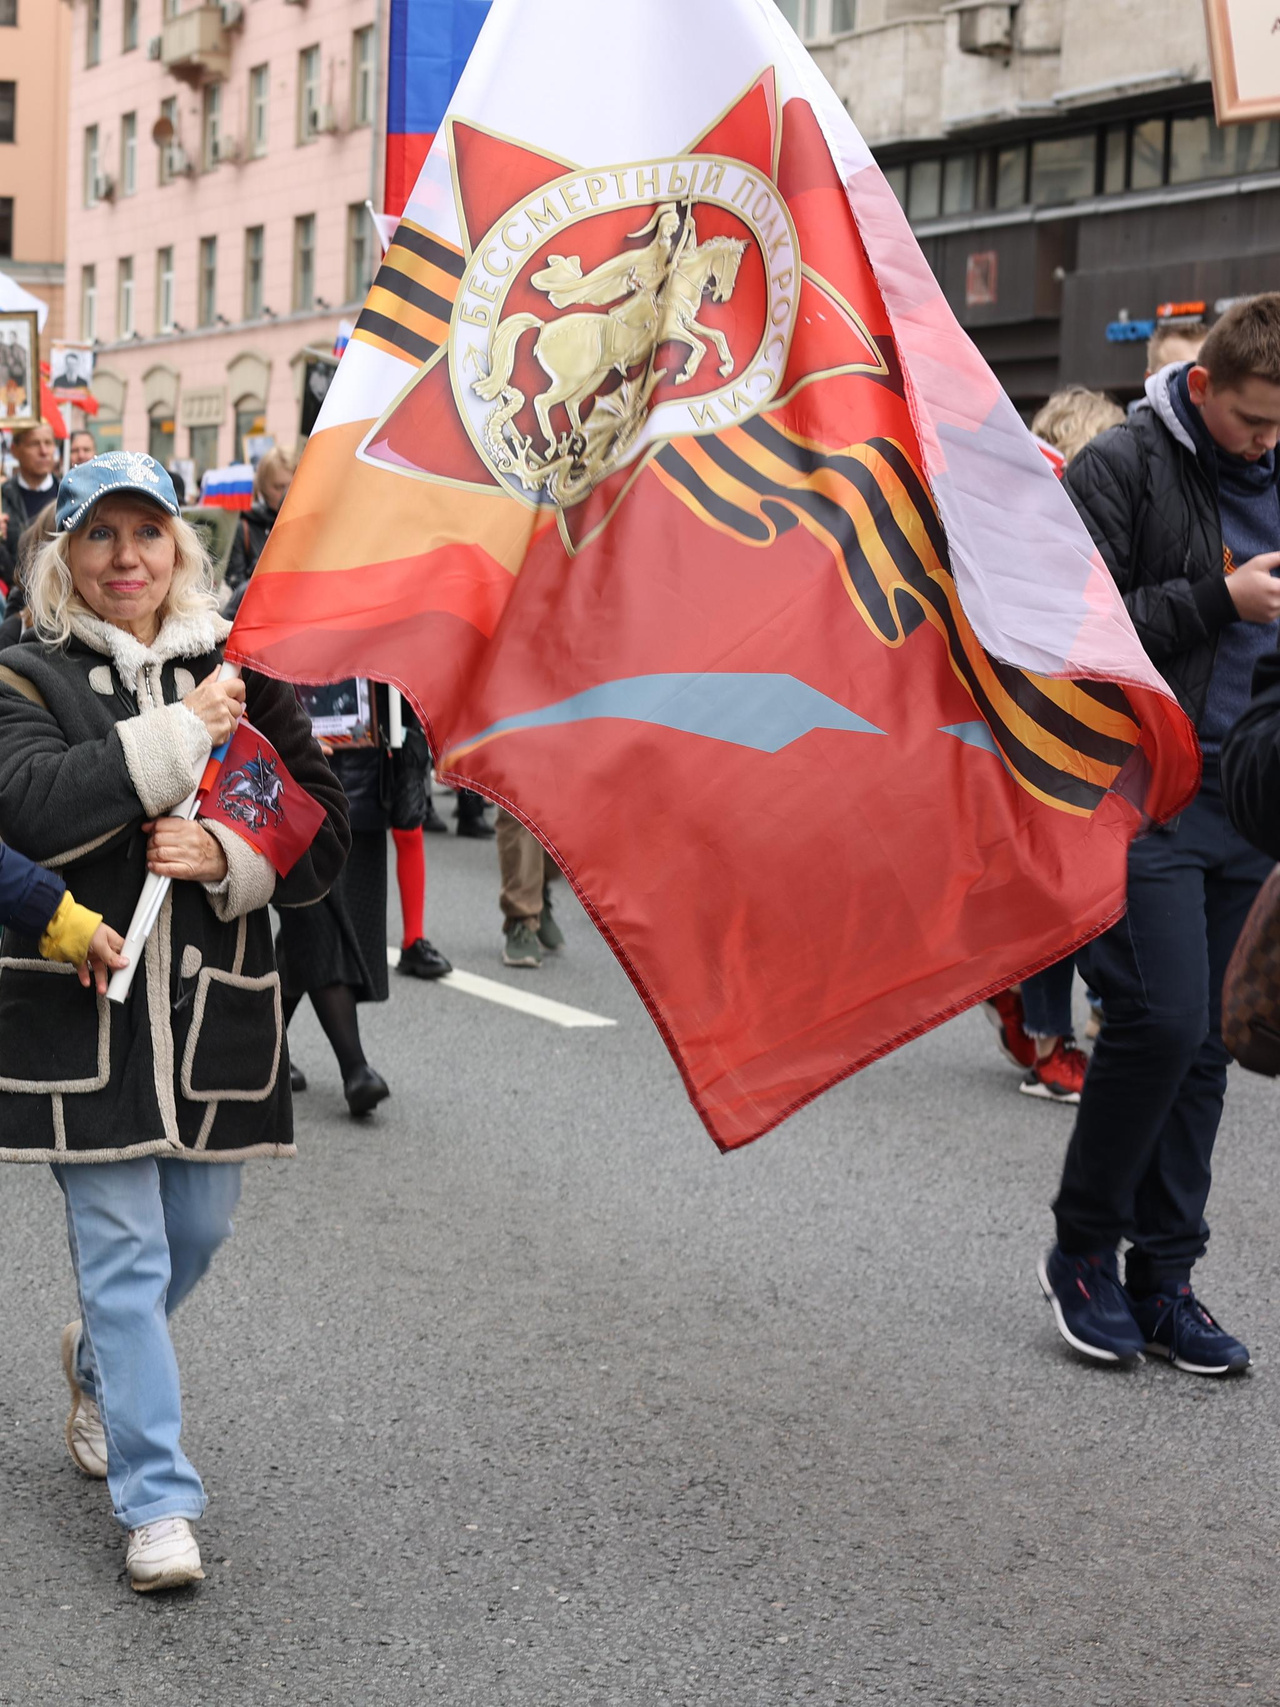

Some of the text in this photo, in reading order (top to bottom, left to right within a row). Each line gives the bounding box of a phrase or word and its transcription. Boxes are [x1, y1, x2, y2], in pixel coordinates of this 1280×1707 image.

[460, 161, 794, 429] БЕССМЕРТНЫЙ ПОЛК РОССИИ
